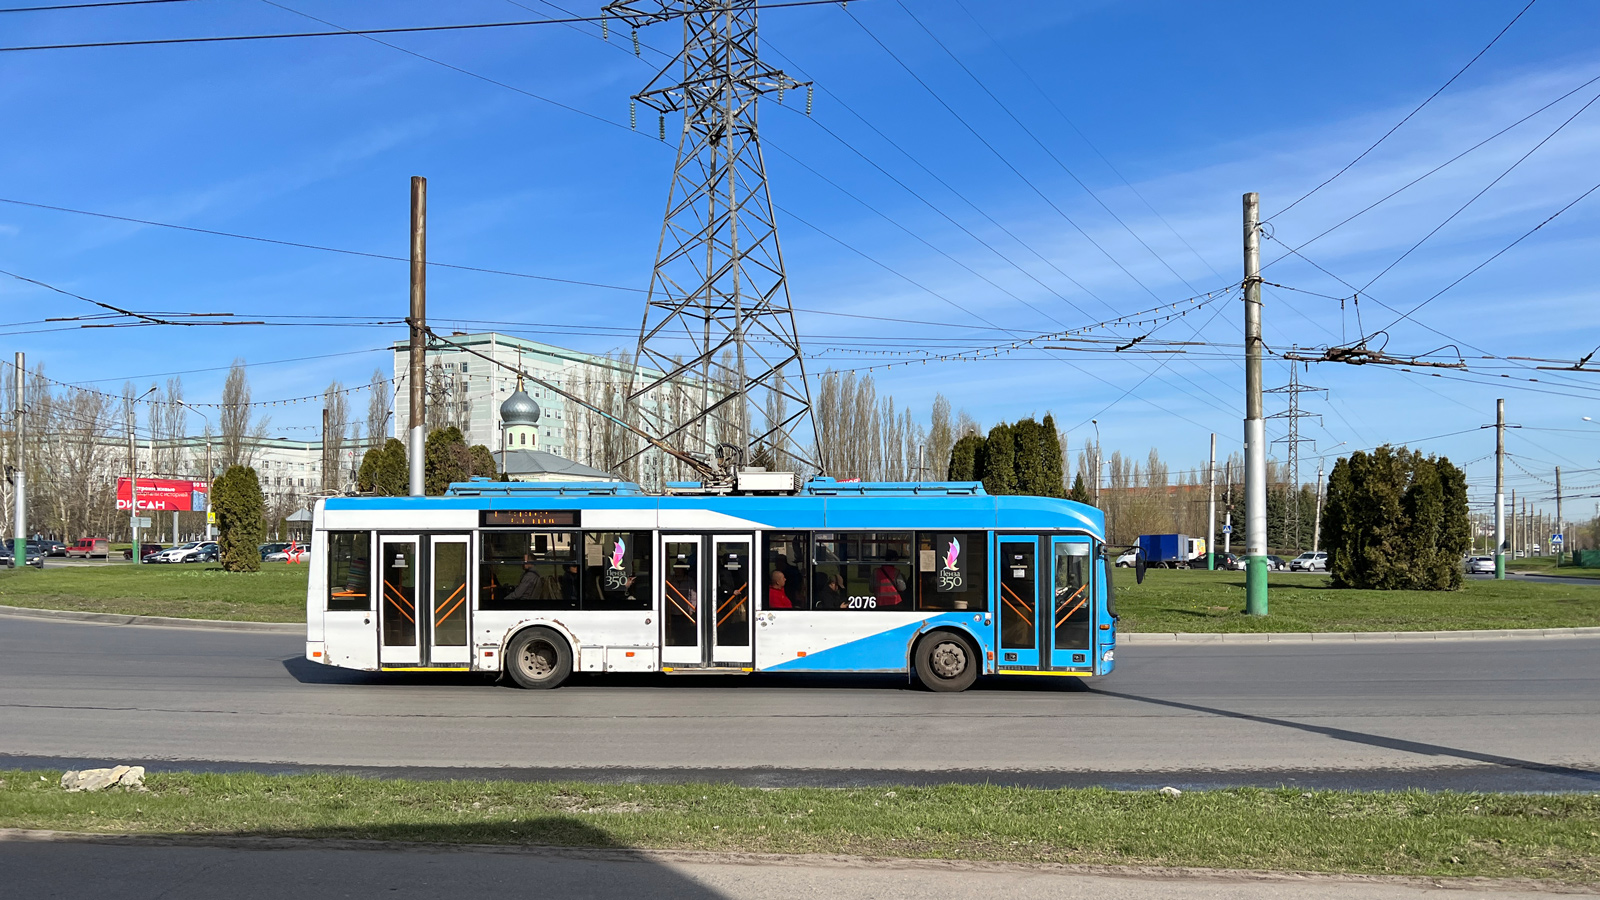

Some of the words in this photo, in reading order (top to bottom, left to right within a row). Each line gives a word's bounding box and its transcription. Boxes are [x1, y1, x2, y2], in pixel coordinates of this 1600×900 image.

[605, 576, 627, 589] 350
[939, 577, 962, 589] 350
[848, 596, 876, 608] 2076
